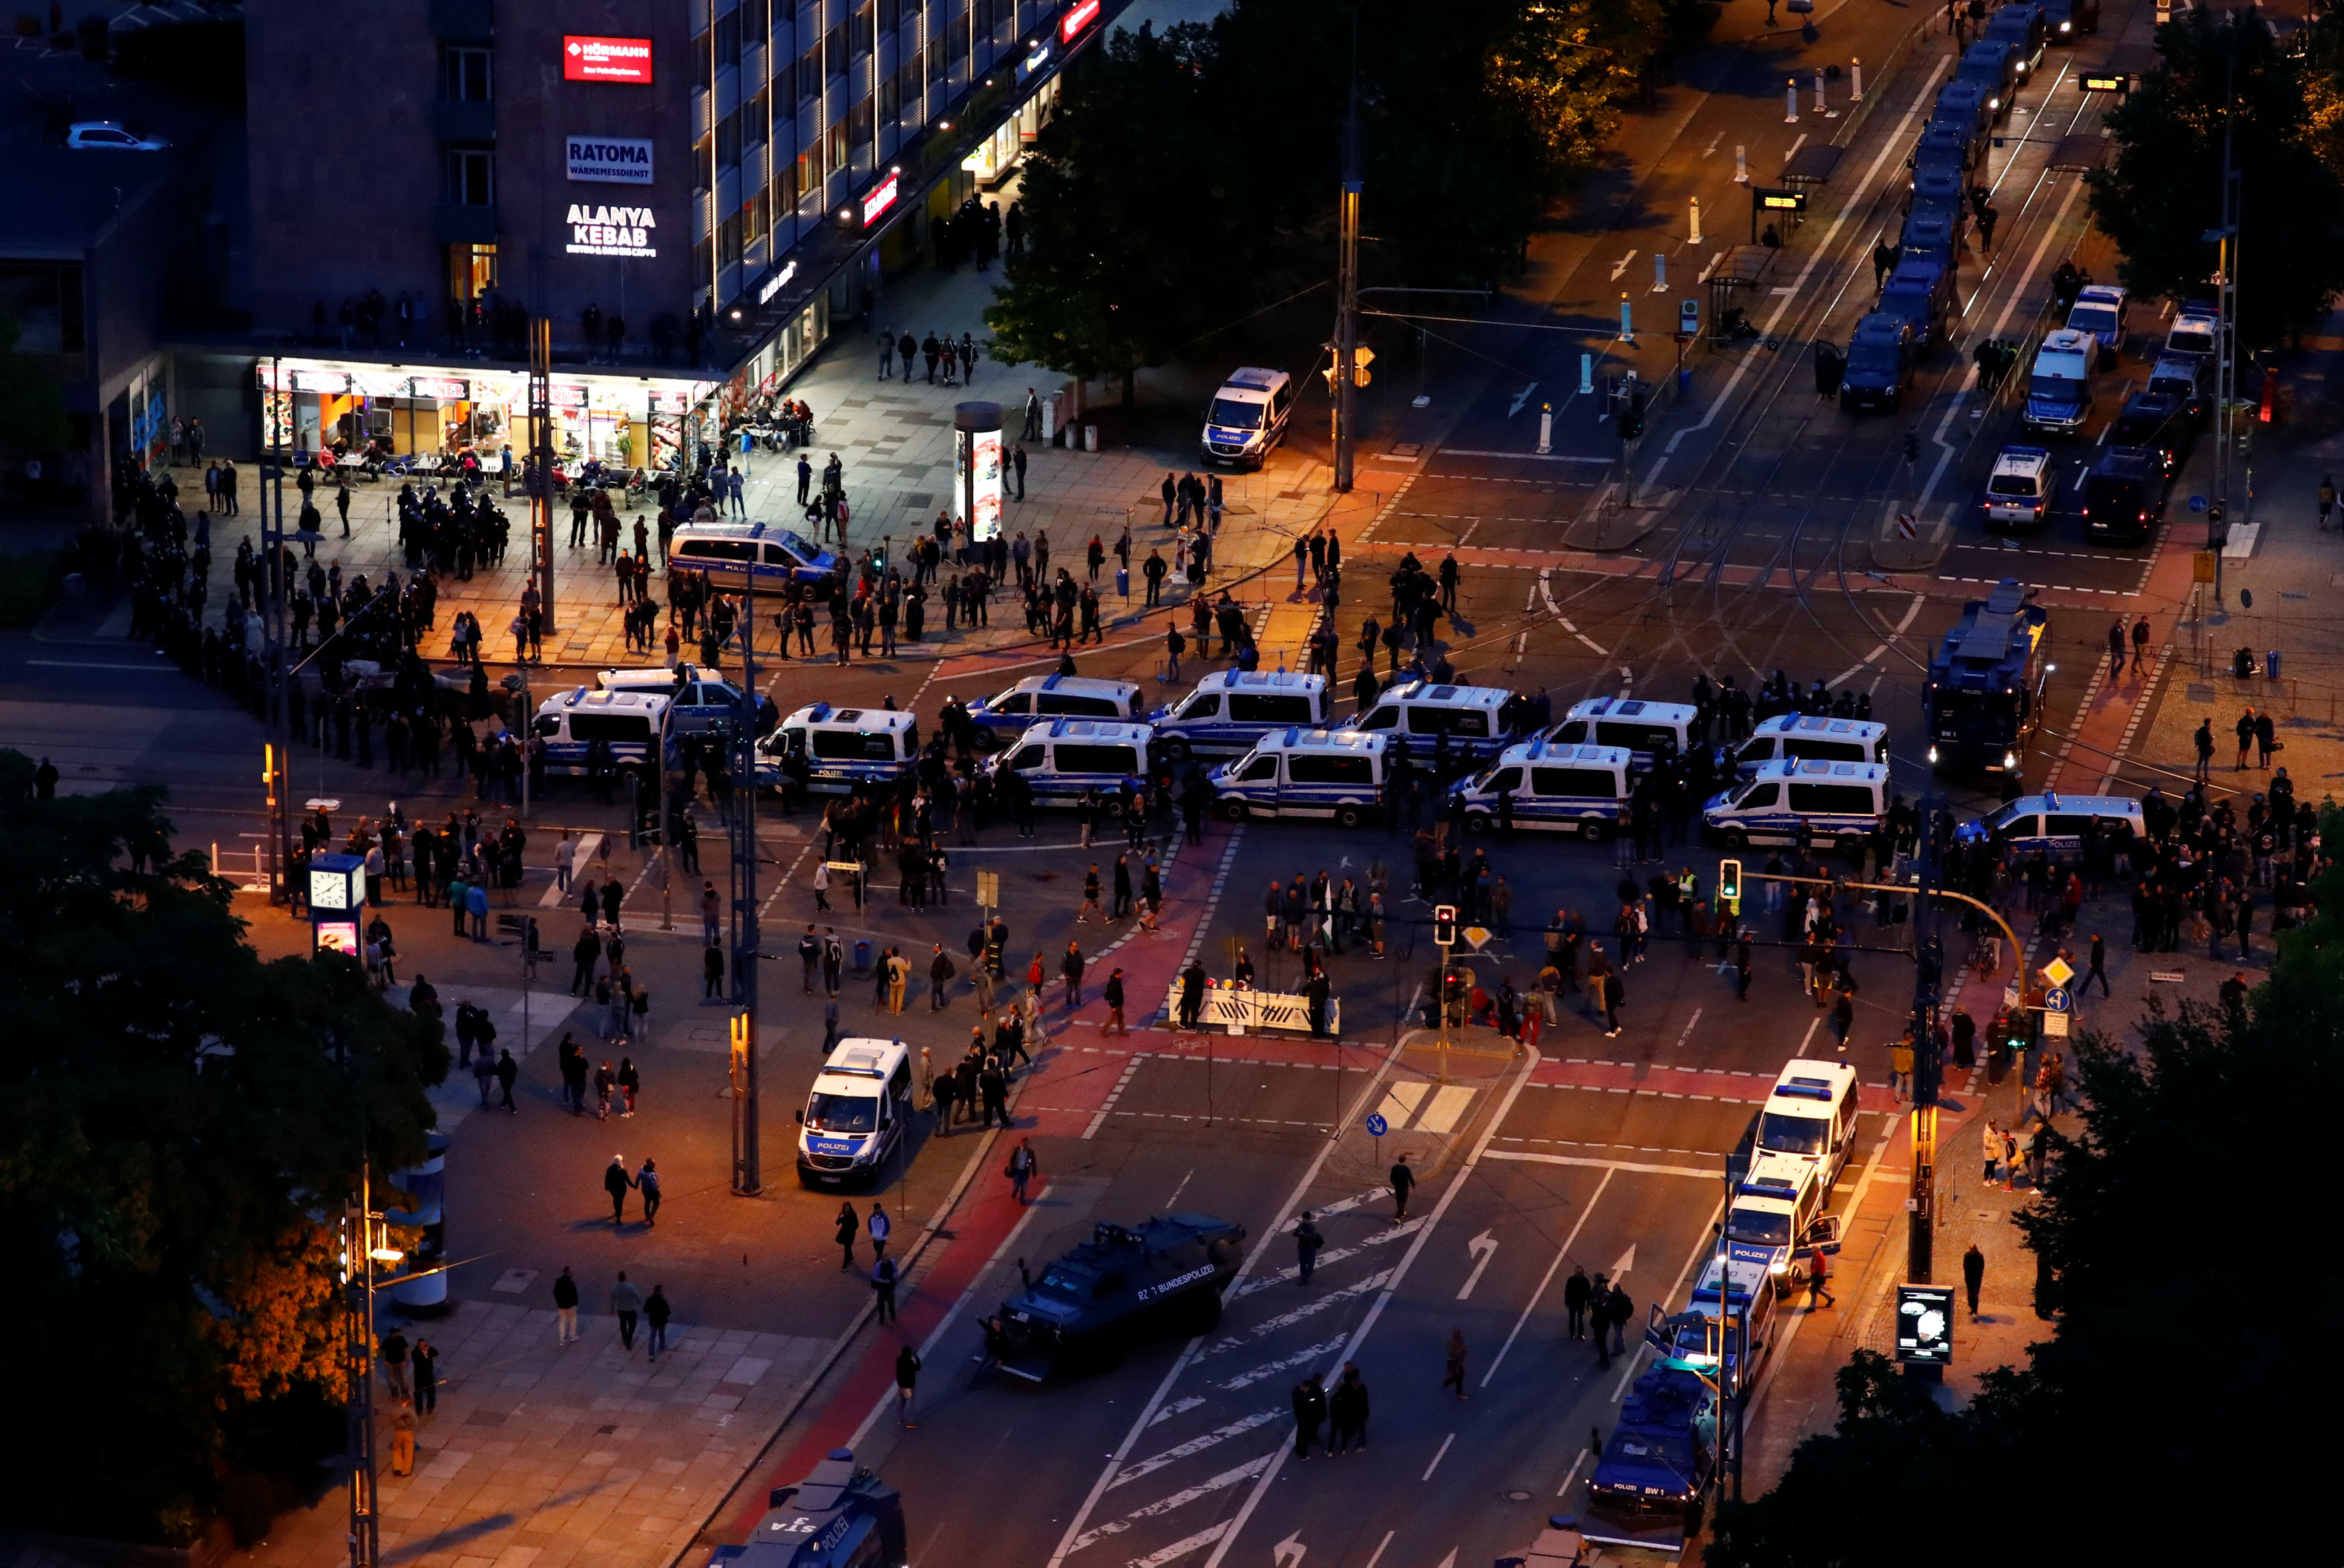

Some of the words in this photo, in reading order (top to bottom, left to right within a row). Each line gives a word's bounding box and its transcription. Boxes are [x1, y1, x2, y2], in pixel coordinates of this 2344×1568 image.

[583, 43, 648, 58] HÖRMANN
[570, 143, 649, 164] RATOMA
[570, 165, 649, 178] WÄRMEMESSDIENST
[567, 204, 656, 228] ALANYA
[575, 225, 647, 247] KEBAB
[415, 378, 465, 398] DÖNER
[2049, 841, 2081, 849] POLIZEI
[817, 1142, 849, 1151] POLIZEI
[1735, 1249, 1767, 1259] POLIZEI
[1138, 1289, 1149, 1301] RZ
[1158, 1264, 1215, 1293] BUNDESPOLIZEI
[1613, 1483, 1637, 1491] POLIZEI
[1645, 1487, 1659, 1495] BW
[771, 1522, 816, 1533] STA
[793, 1517, 809, 1525] 3
[822, 1515, 850, 1552] POLIZEI
